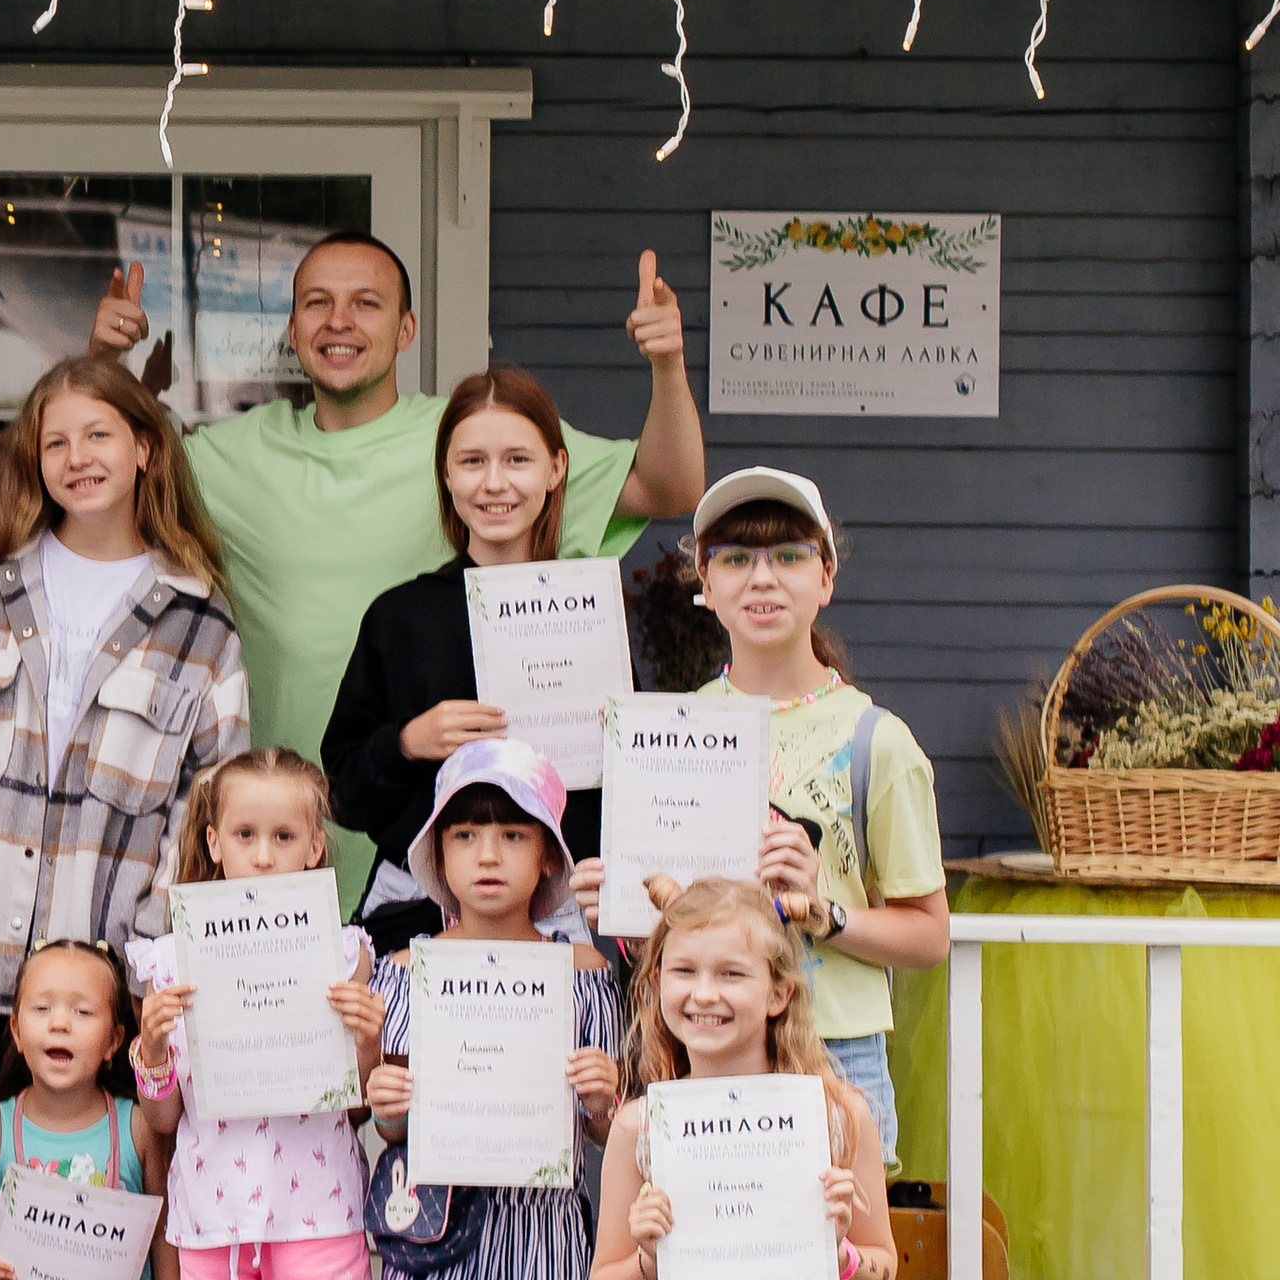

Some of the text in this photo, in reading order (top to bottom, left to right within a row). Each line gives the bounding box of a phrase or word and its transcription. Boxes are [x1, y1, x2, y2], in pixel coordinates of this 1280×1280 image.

[762, 281, 950, 329] КАФЕ
[729, 342, 979, 364] СУВЕНИРНАЯ ЛАВКА
[498, 594, 596, 619] ДИПЛОМ
[631, 732, 738, 750] ДИПЛОМ
[204, 911, 309, 938] ДИПЛОМ
[440, 979, 545, 997] ДИПЛОМ
[682, 1116, 794, 1138] ДИПЛОМ
[23, 1202, 126, 1243] ДИПЛОМ
